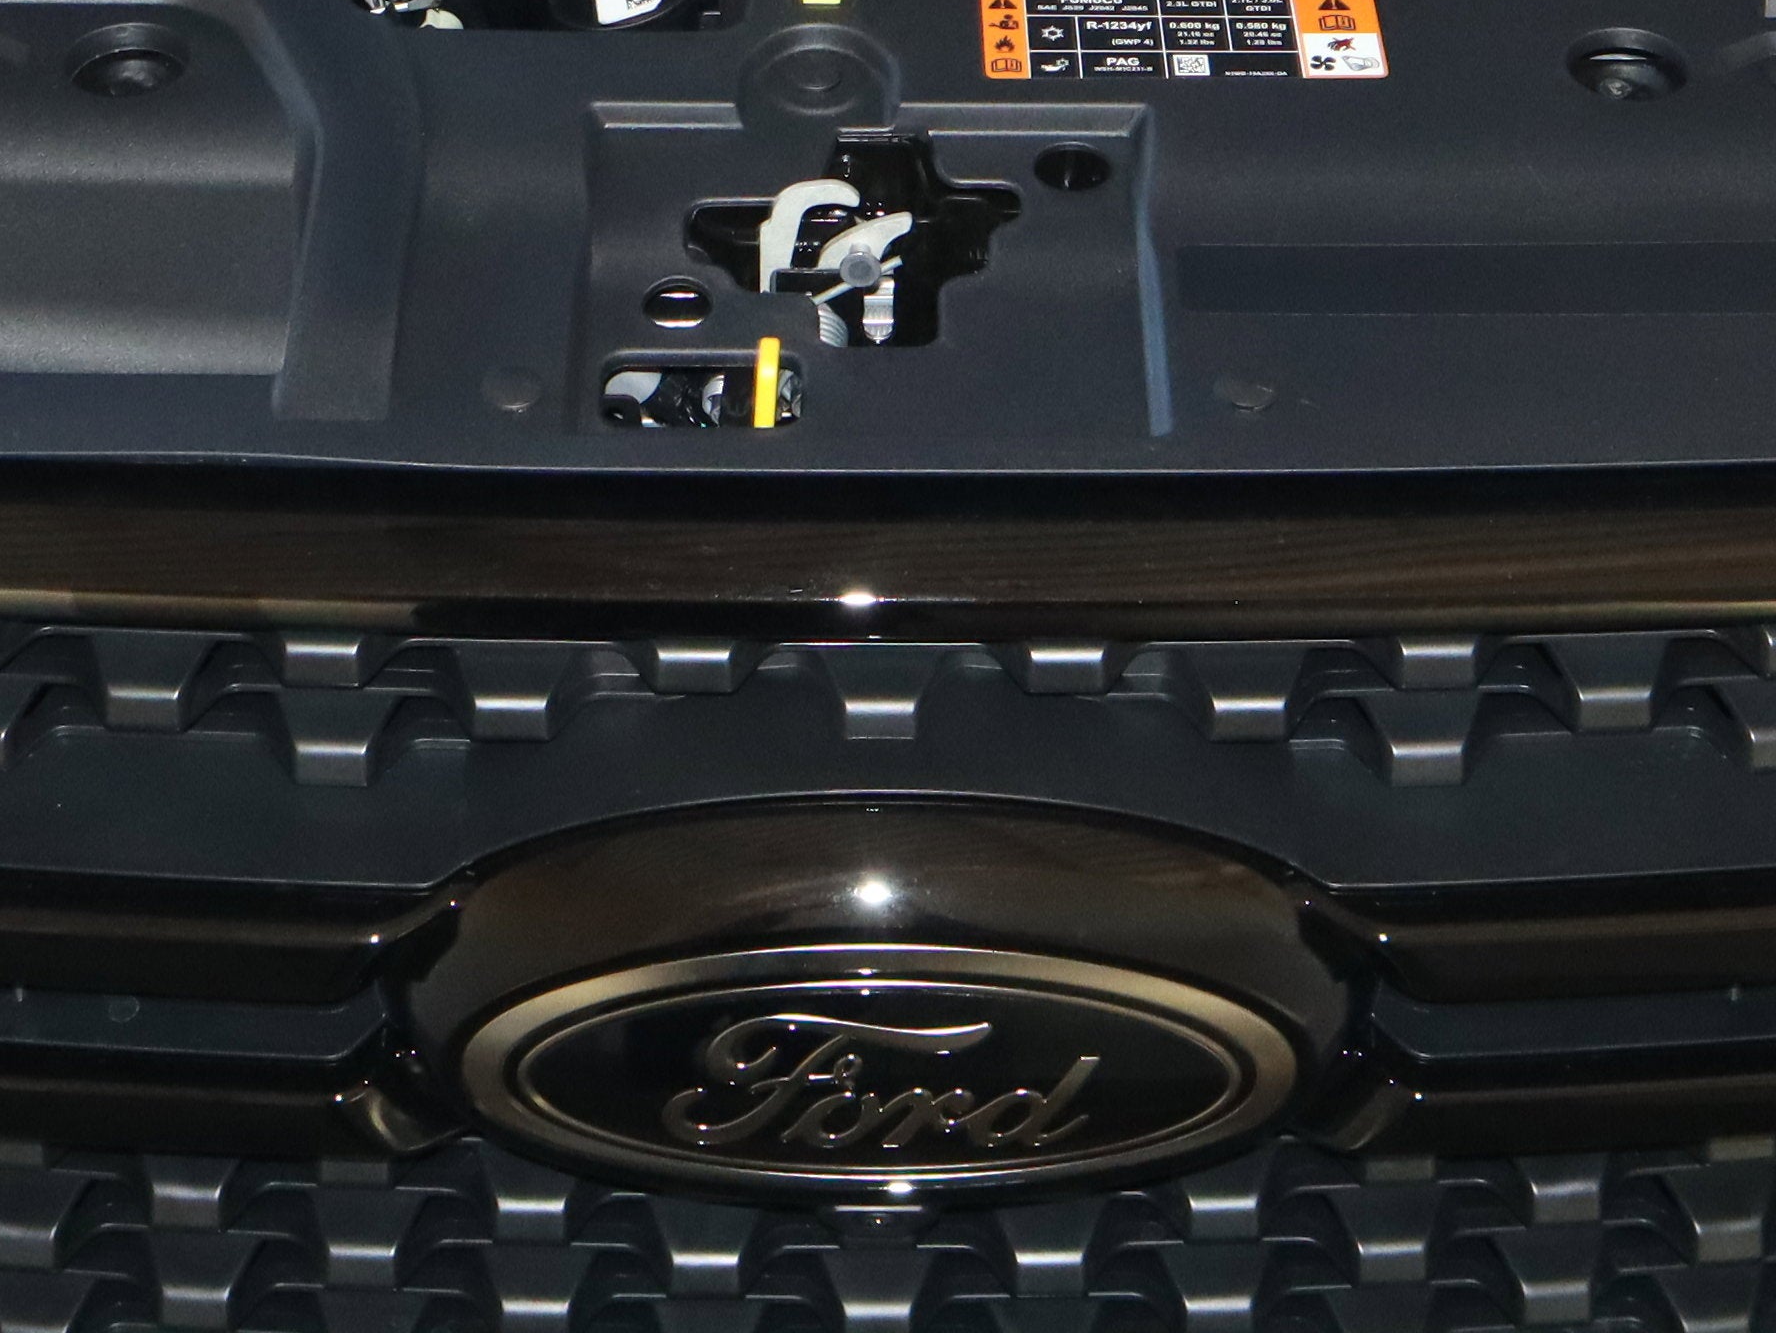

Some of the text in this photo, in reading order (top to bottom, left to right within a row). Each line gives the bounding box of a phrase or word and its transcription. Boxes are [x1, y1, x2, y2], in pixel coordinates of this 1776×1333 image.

[1086, 21, 1152, 31] R-1234yf
[1204, 22, 1220, 30] kg
[1271, 22, 1286, 31] kg
[1106, 57, 1140, 66] PAG
[663, 1012, 1102, 1149] Ford
